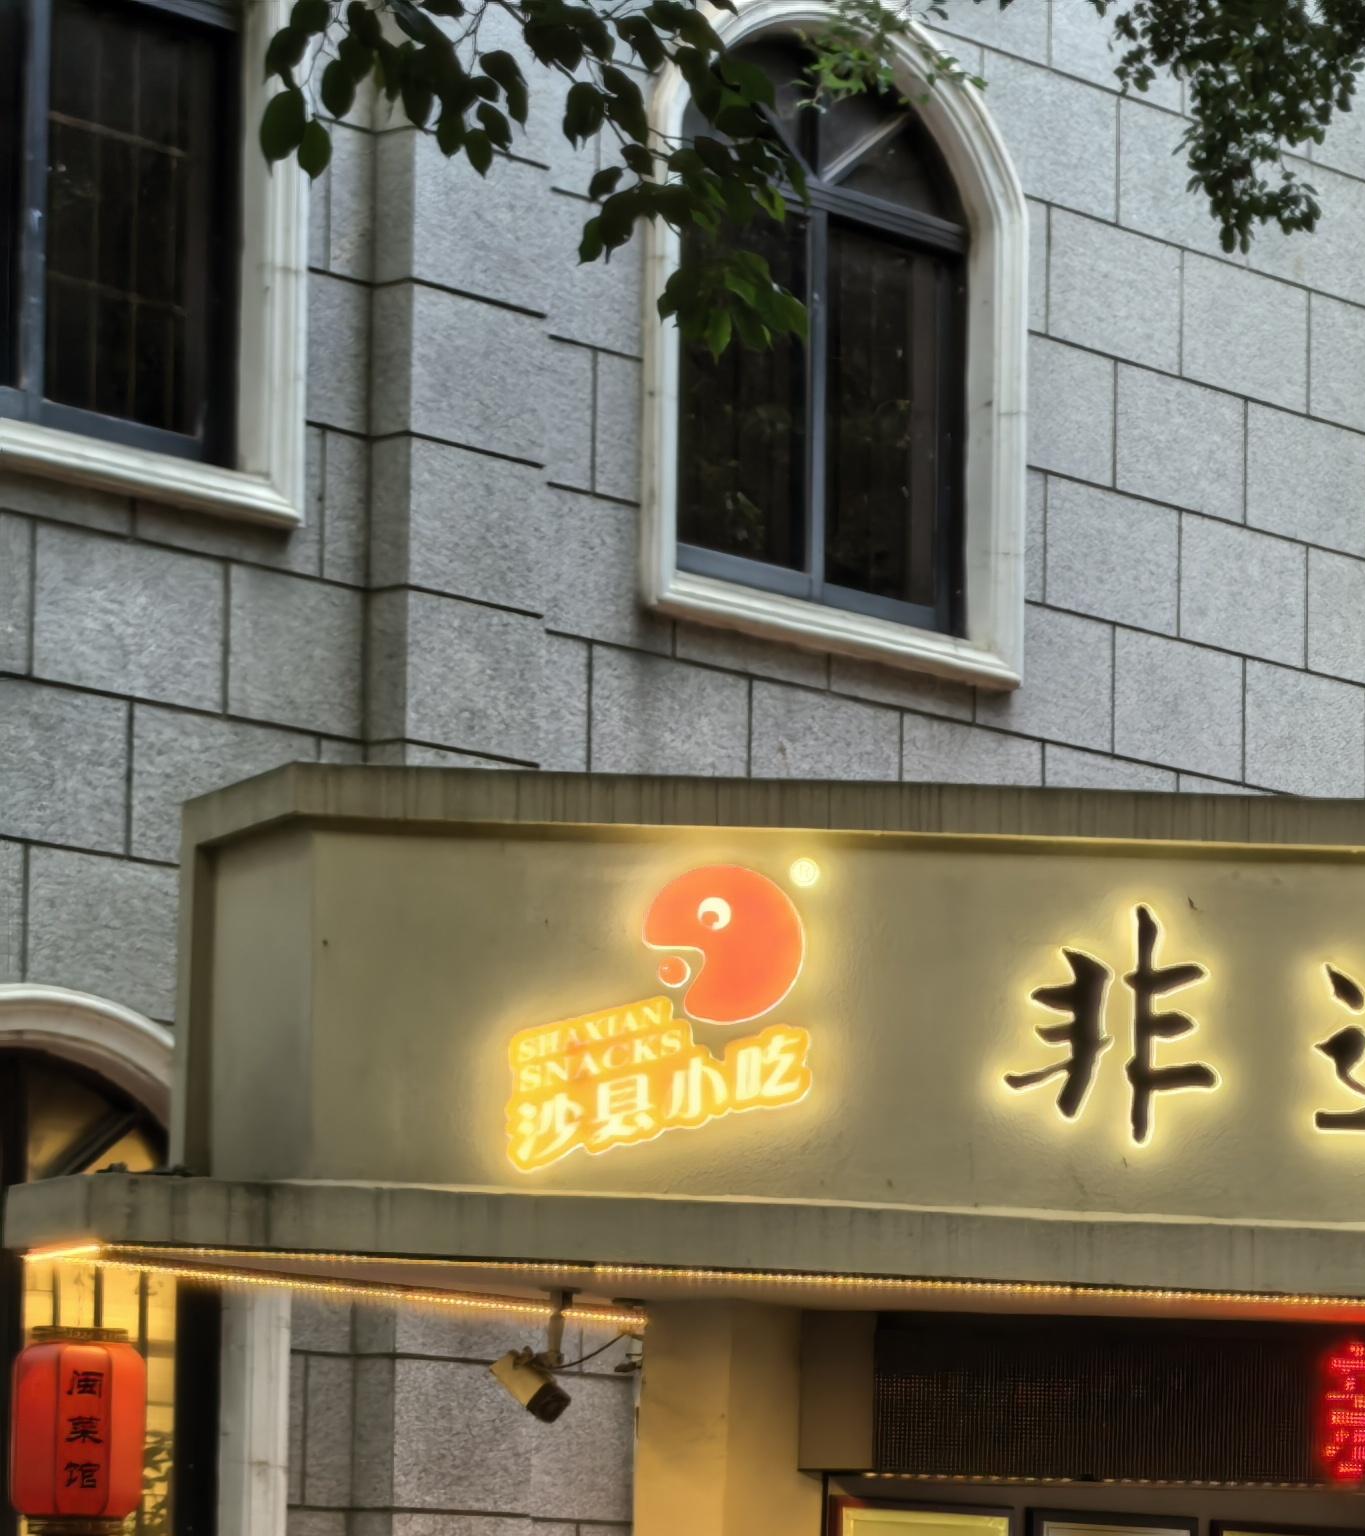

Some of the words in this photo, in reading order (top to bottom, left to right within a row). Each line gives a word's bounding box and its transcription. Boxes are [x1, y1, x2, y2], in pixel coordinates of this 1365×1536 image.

[518, 1000, 664, 1062] SHAXIAN
[518, 1028, 683, 1093] SNACKS
[516, 1033, 804, 1163] 沙县小吃
[63, 1369, 106, 1490] 闽菜馆
